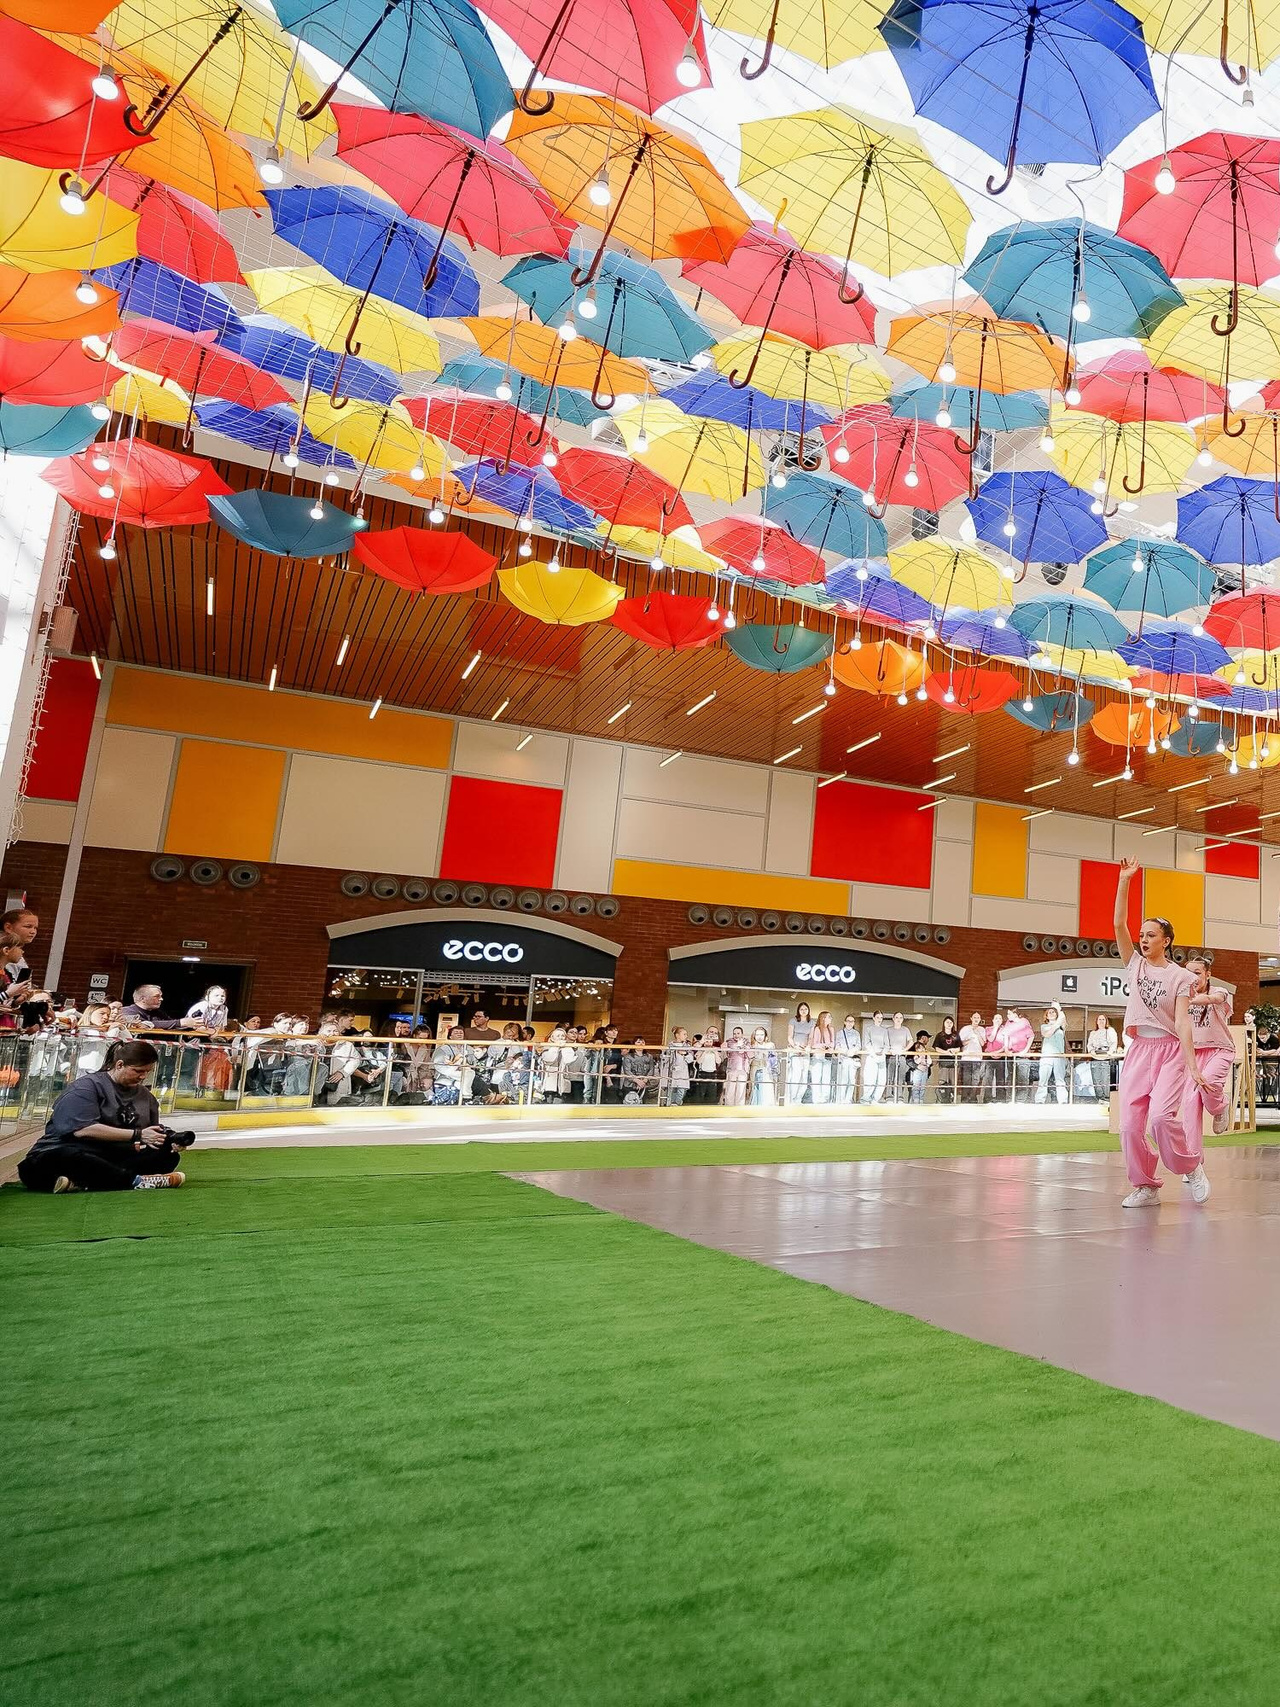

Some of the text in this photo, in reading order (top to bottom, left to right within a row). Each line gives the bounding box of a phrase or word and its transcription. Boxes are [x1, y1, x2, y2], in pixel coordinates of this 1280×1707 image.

[442, 940, 524, 963] ecco
[93, 976, 107, 984] WC
[795, 963, 856, 983] ecco
